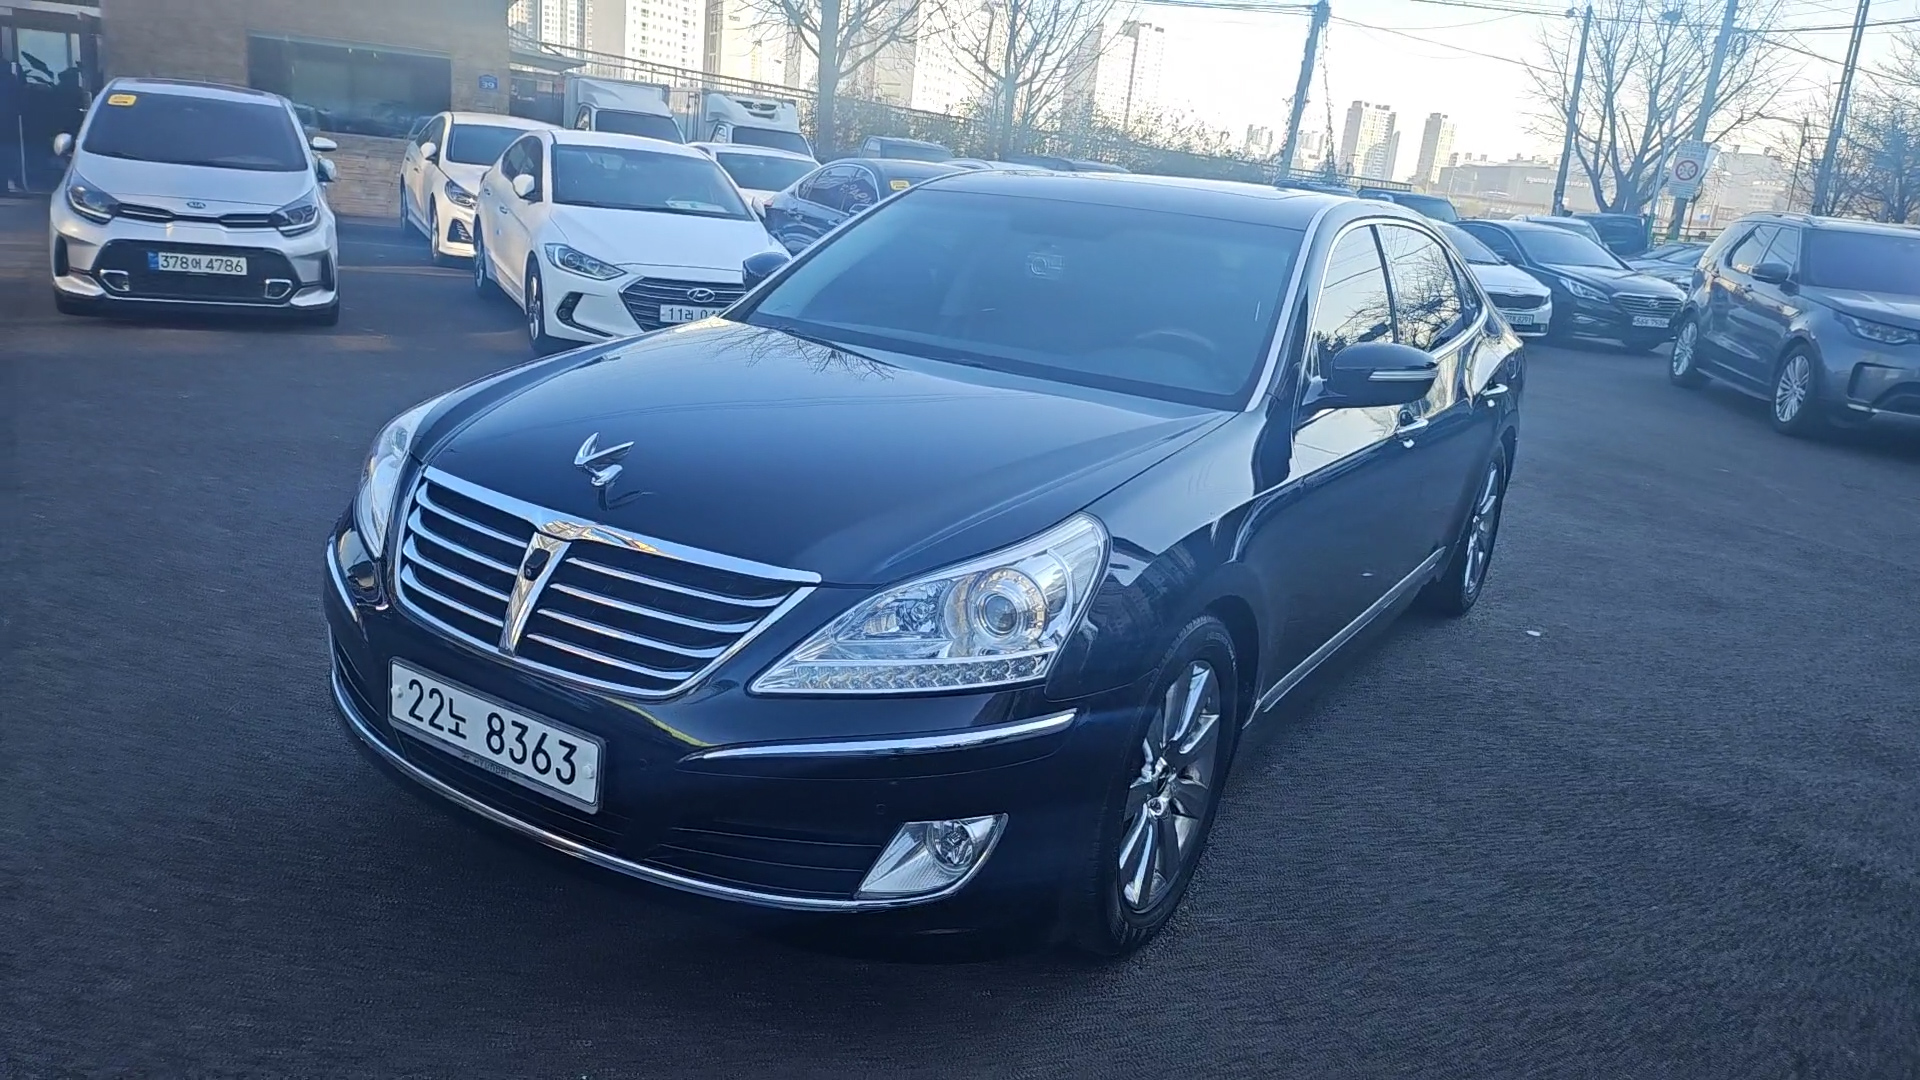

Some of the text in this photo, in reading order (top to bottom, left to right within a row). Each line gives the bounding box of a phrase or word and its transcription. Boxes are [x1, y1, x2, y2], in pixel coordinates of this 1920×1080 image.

[161, 255, 243, 273] 378어 4786
[408, 679, 577, 785] 22노 8363
